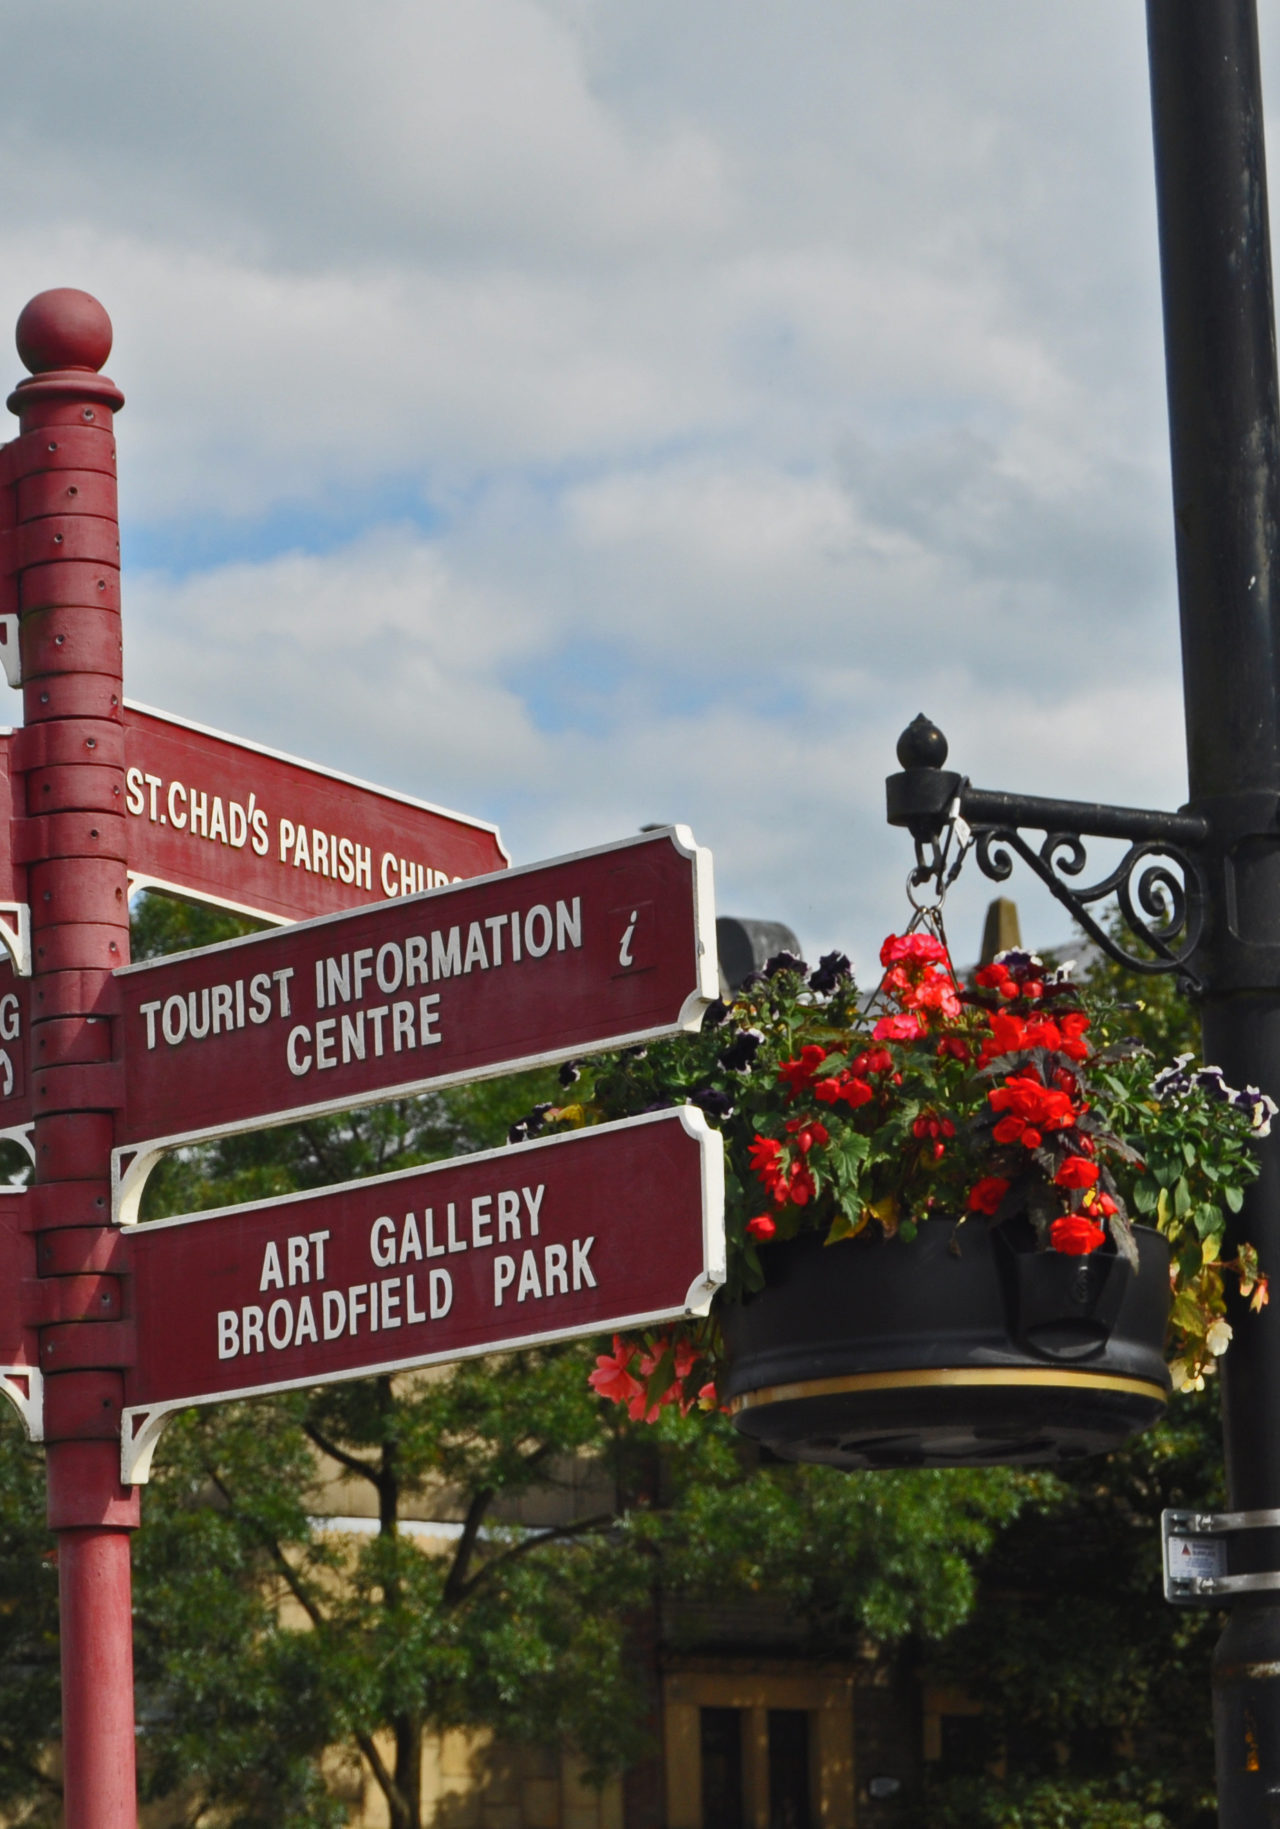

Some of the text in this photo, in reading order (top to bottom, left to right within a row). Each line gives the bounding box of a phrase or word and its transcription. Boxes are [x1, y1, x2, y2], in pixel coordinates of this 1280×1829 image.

[127, 767, 268, 855] ST.CHAD'S
[280, 819, 371, 890] PARISH
[140, 897, 581, 1049] TOURIST INFORMATION
[287, 994, 441, 1075] CENTRE
[218, 1237, 596, 1359] BROADFIELD PARK
[260, 1185, 544, 1291] ART GALLERY
